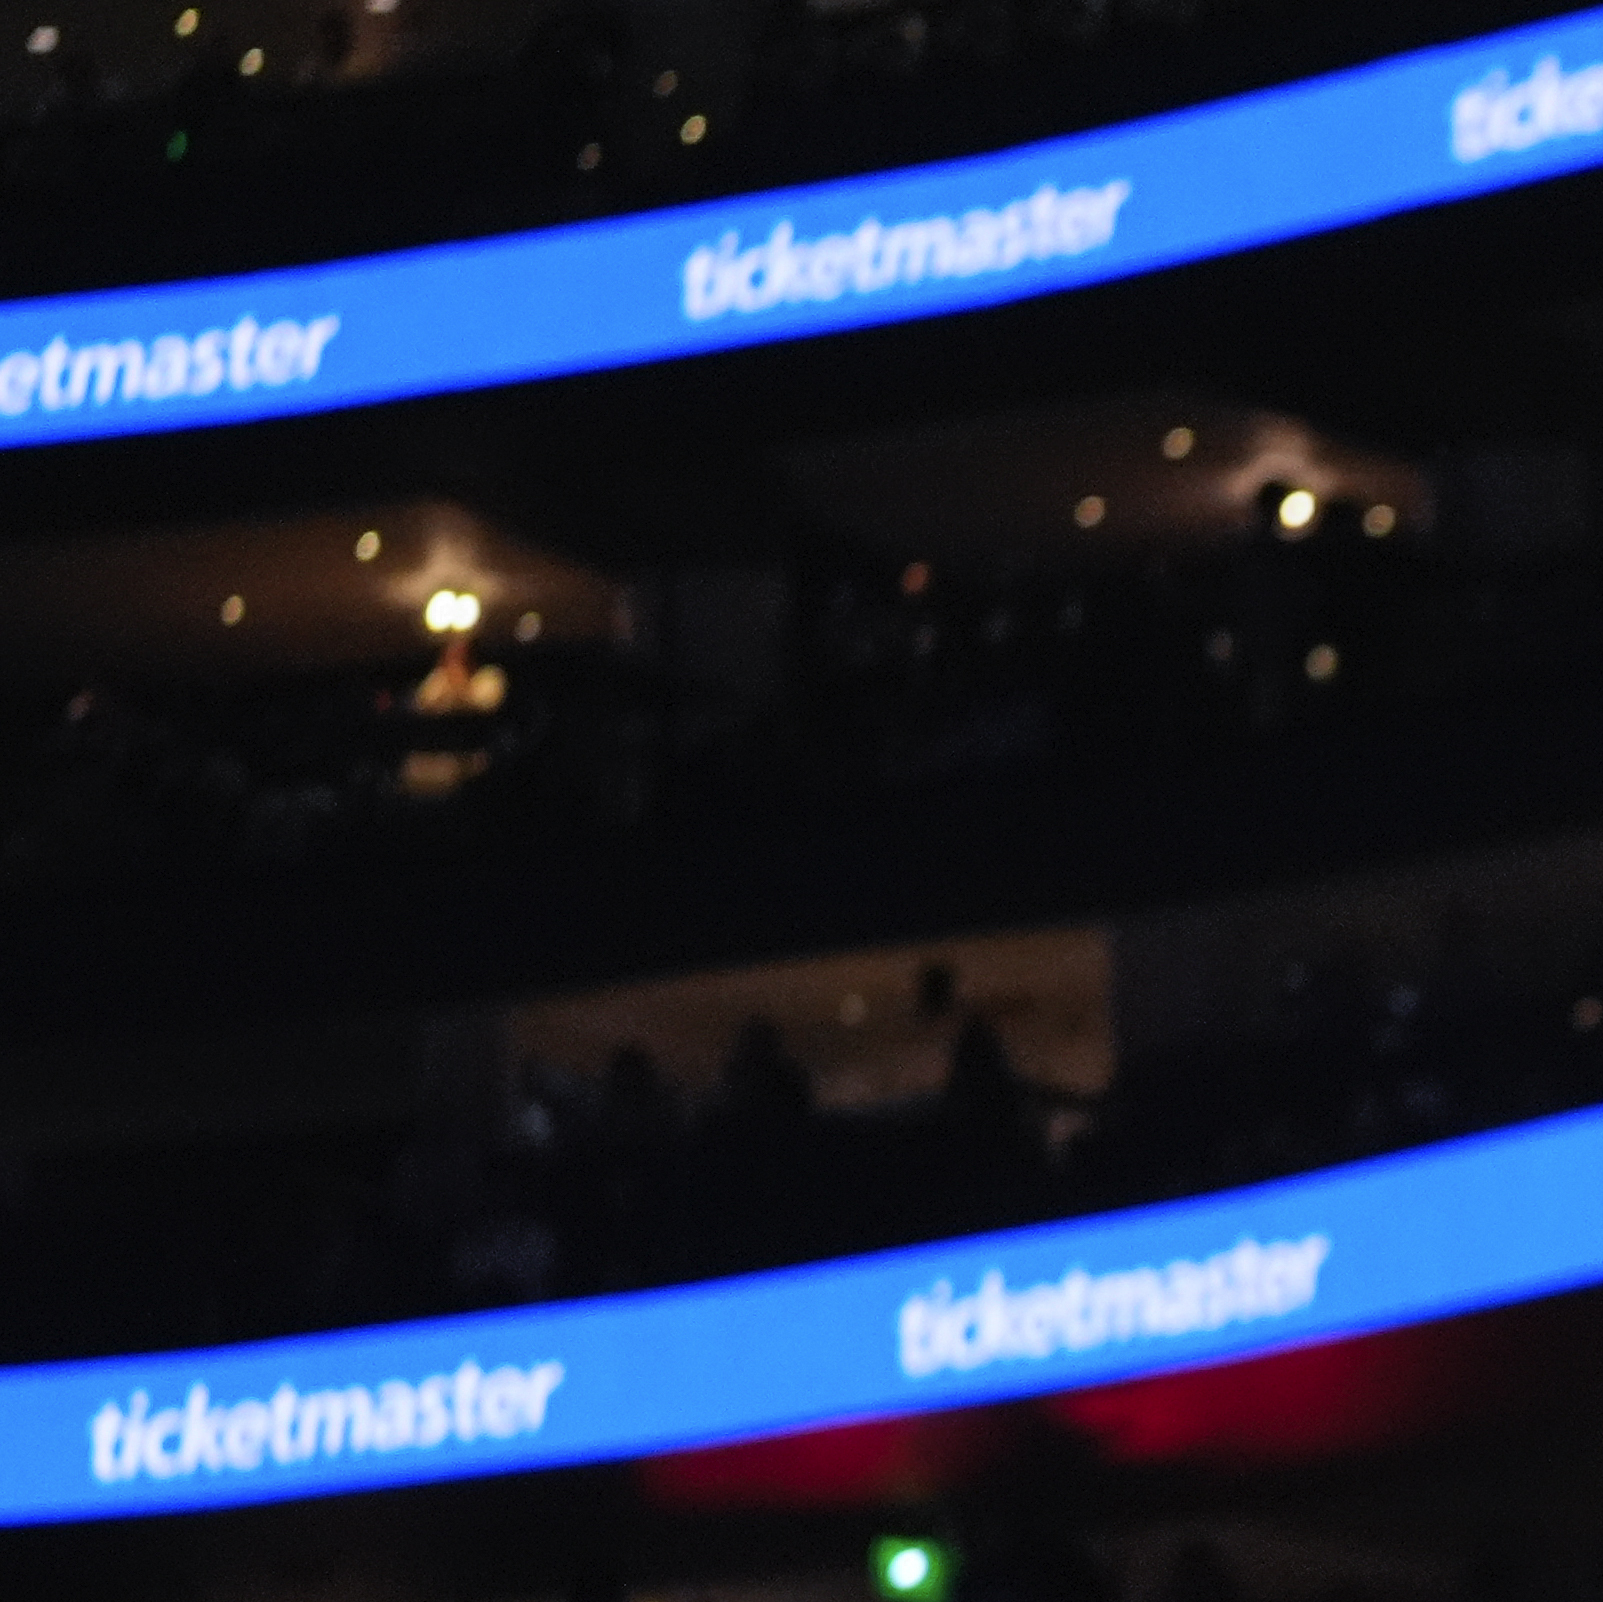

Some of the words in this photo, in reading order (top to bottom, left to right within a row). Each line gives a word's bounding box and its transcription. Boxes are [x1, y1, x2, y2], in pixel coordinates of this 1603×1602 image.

[683, 180, 1131, 321] ticketmaster
[898, 1234, 1330, 1378] ticketmaster
[91, 1361, 564, 1483] ticketmaster
